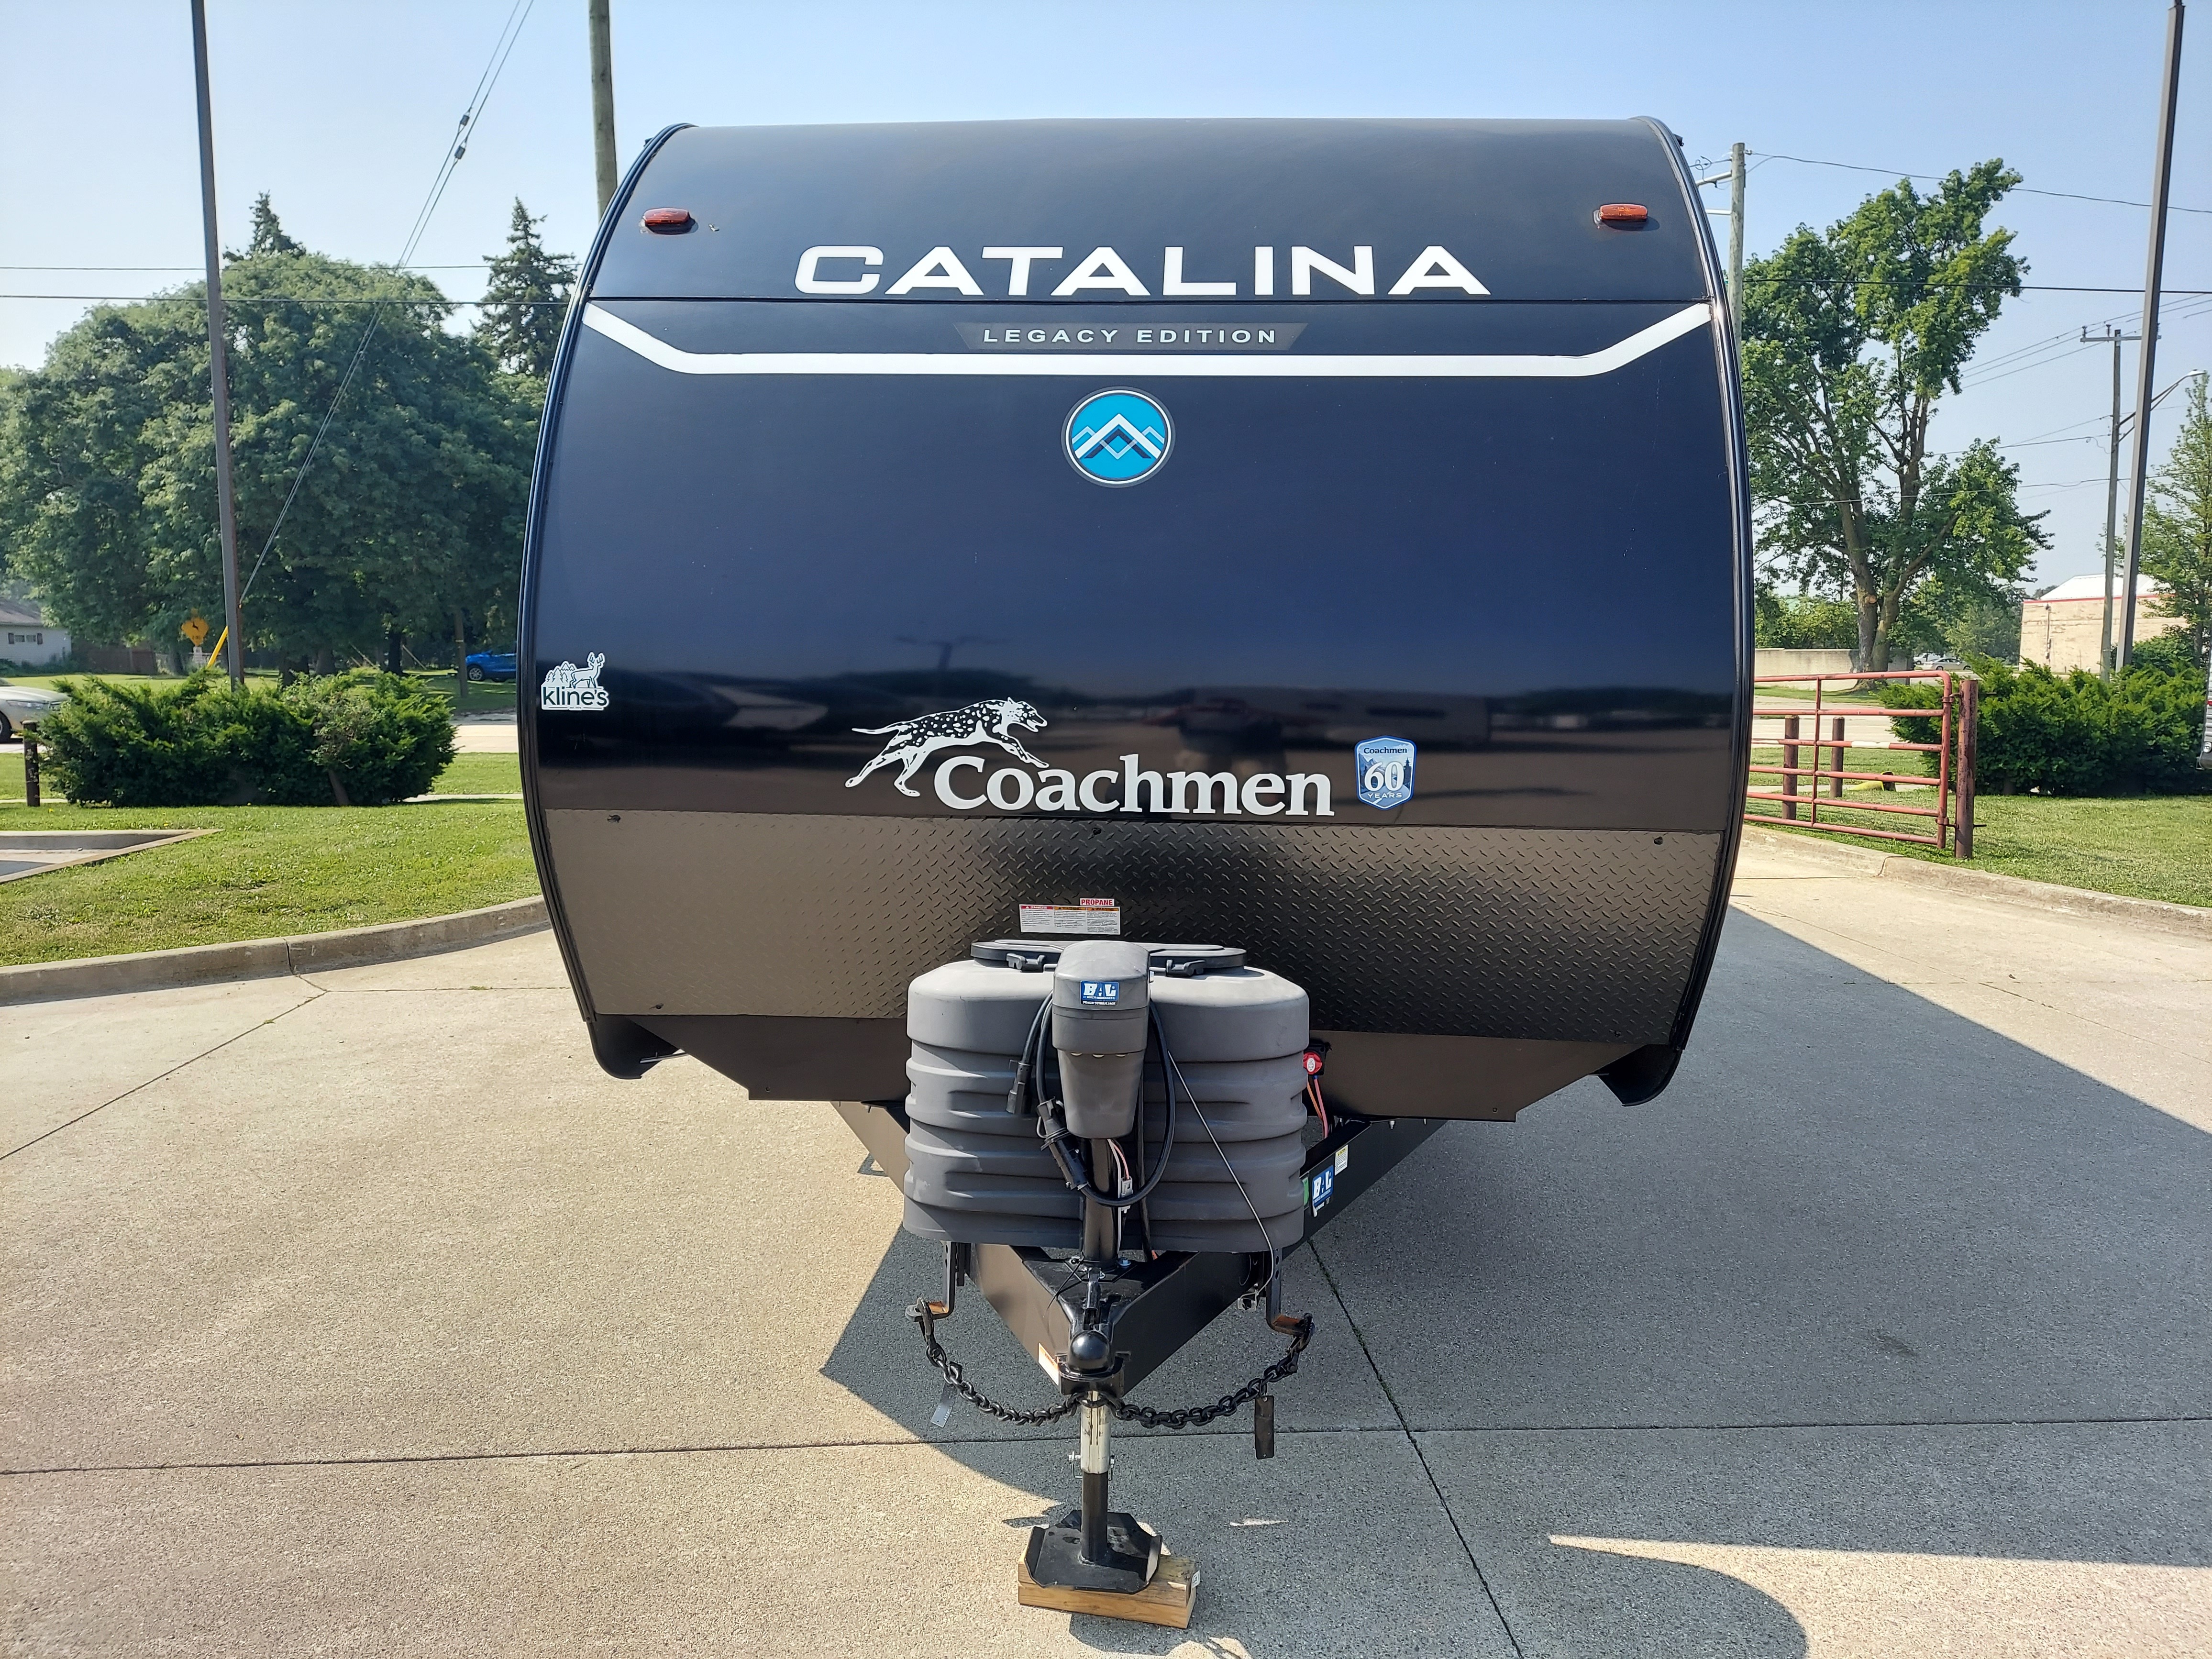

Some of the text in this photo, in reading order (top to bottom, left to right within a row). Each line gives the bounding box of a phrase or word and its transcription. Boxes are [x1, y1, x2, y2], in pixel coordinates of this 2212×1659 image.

[794, 245, 1492, 296] CATALINA
[983, 329, 1275, 343] LEGACY EDITION
[542, 686, 608, 706] kline's
[934, 753, 1335, 817] Coachmen
[1364, 761, 1405, 792] 60
